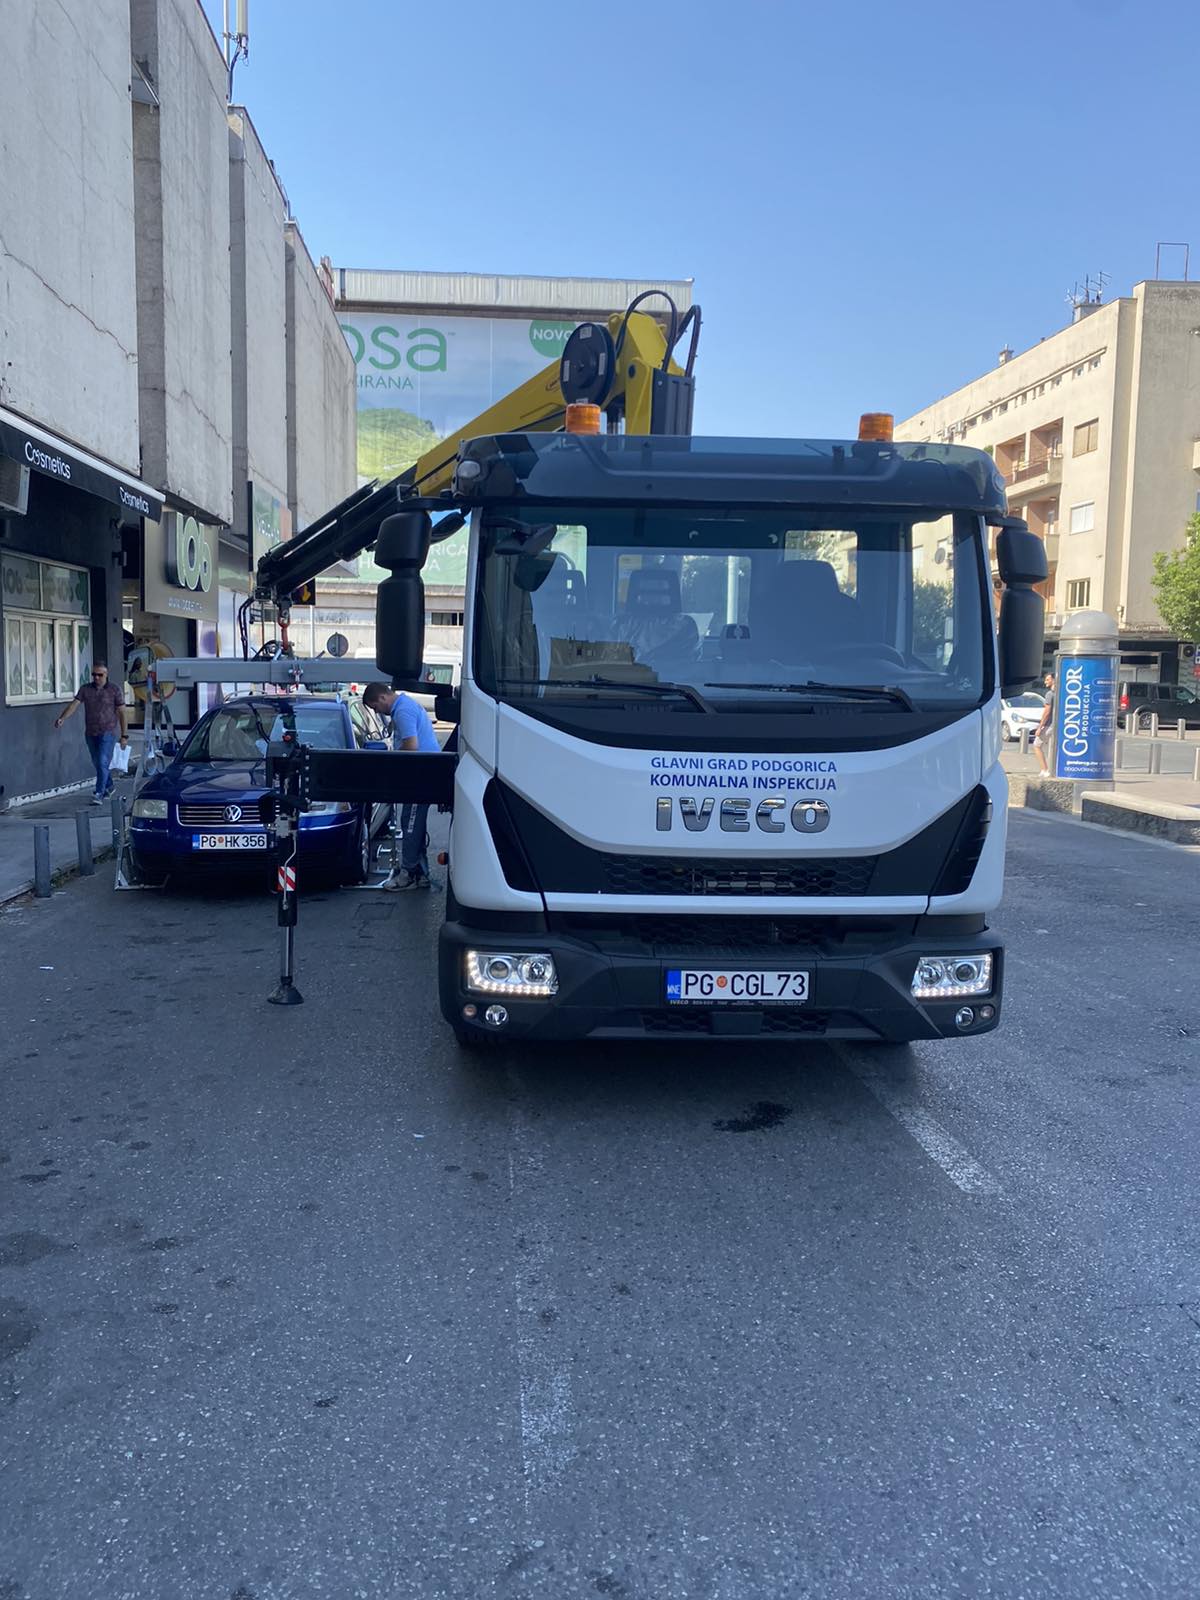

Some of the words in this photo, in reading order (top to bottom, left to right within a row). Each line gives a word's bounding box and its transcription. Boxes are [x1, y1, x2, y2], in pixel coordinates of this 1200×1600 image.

[357, 375, 414, 389] IRANA
[24, 441, 71, 479] Cosmetics
[119, 486, 150, 513] Cosmetics
[1062, 665, 1089, 757] GONDOR
[1081, 683, 1091, 737] PRODUKCIJA
[651, 756, 704, 769] GLAVNI
[707, 758, 748, 771] GRAD
[752, 759, 837, 773] PODGORICA
[650, 773, 749, 789] KOMUNALNA
[752, 776, 837, 791] INSPEKCIJA
[656, 797, 831, 833] IVECO
[201, 835, 217, 848] PG
[685, 973, 714, 996] PG
